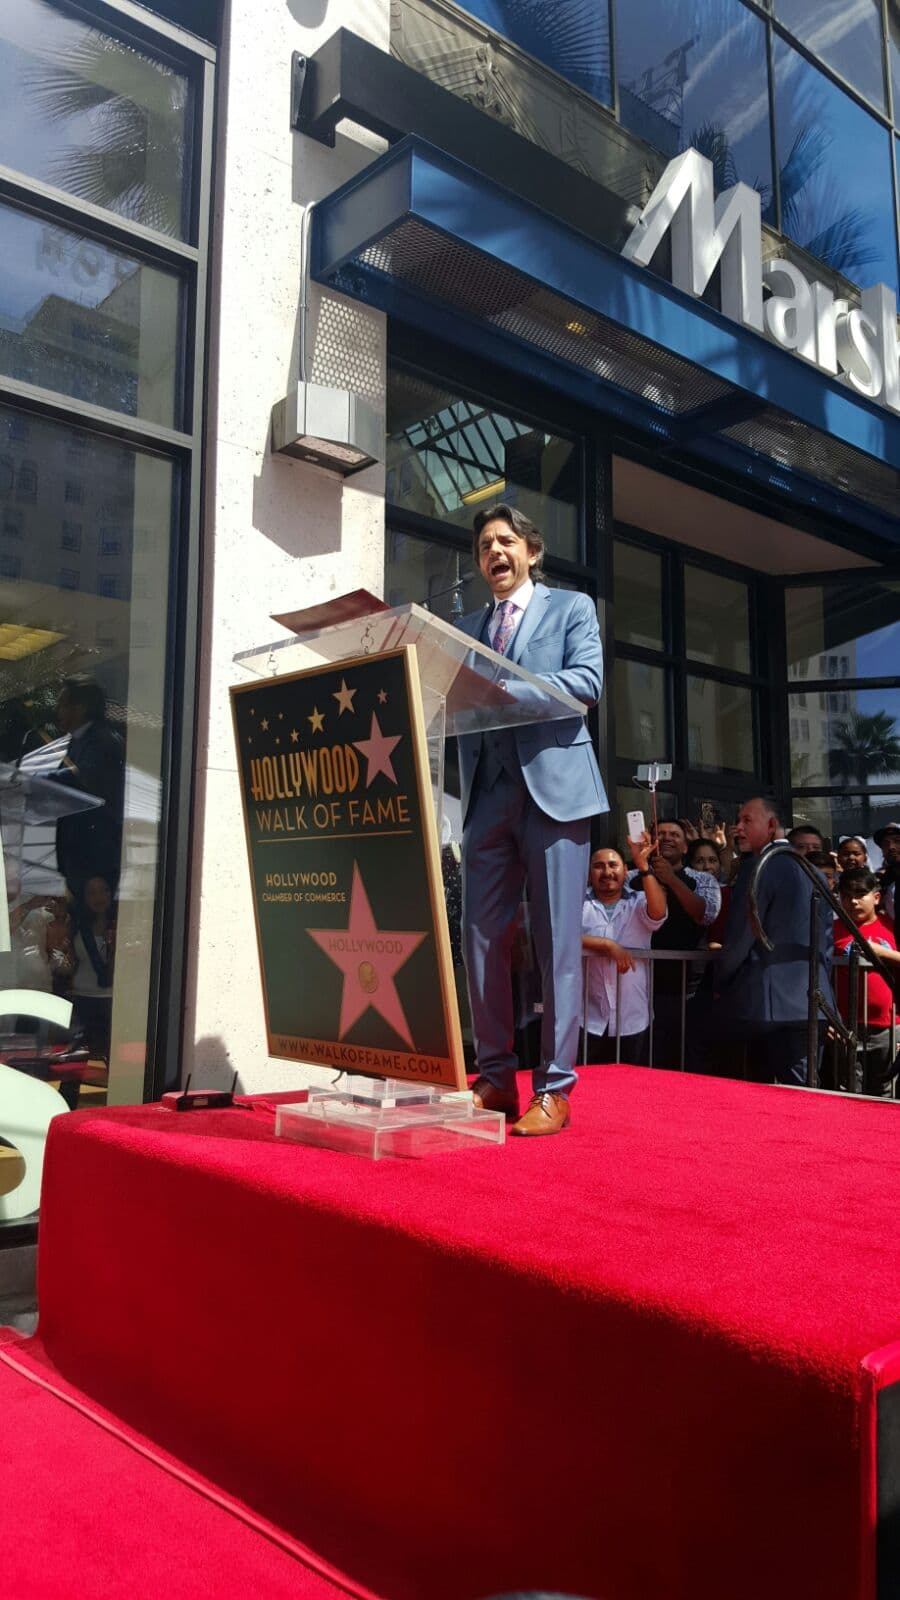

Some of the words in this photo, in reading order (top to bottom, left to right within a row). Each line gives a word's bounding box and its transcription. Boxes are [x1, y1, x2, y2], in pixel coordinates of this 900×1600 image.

[251, 744, 360, 801] HOLLYWOOD
[256, 805, 309, 833] WALK
[313, 802, 342, 829] OF
[349, 795, 411, 827] FAME
[265, 872, 337, 887] HOLLYWOOD
[262, 893, 292, 902] CHAMBER
[294, 893, 304, 902] OF
[305, 892, 346, 902] COMMERCE
[328, 937, 404, 954] HOLLYWOOD
[278, 1039, 443, 1077] WWW.WALKOFFAME.COM
